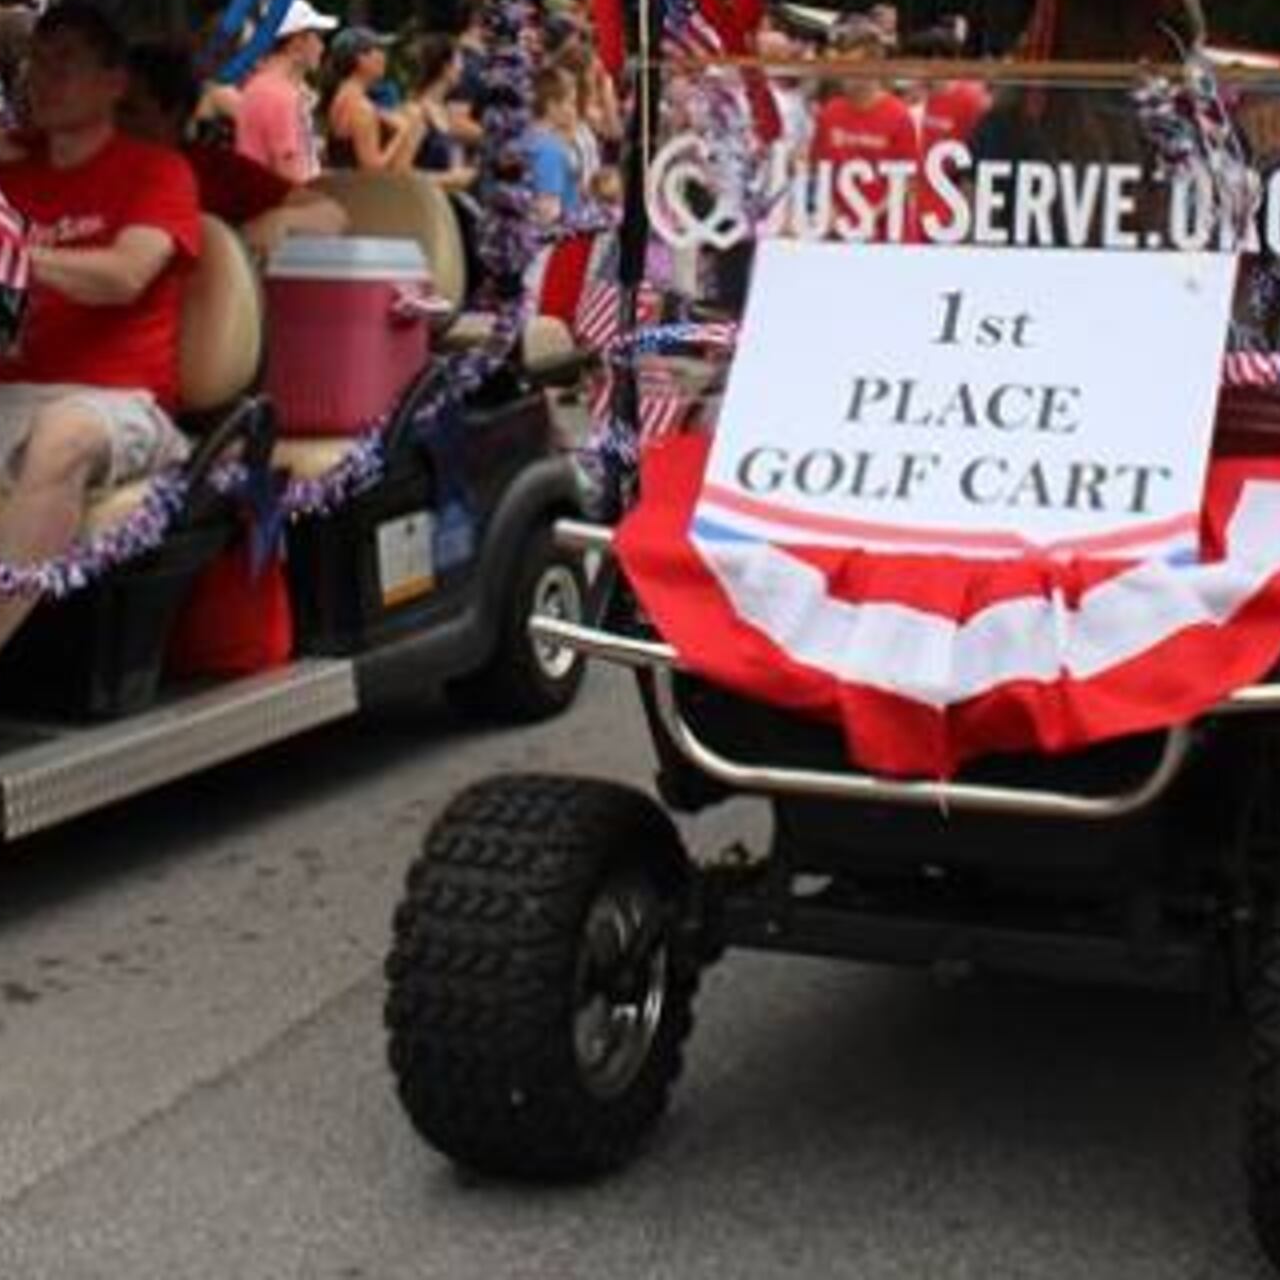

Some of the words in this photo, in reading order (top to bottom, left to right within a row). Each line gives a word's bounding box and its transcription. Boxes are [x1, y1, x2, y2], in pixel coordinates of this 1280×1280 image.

[931, 289, 1037, 349] 1st
[844, 375, 1082, 434] PLACE
[736, 445, 939, 502] GOLF
[958, 454, 1172, 514] CART
